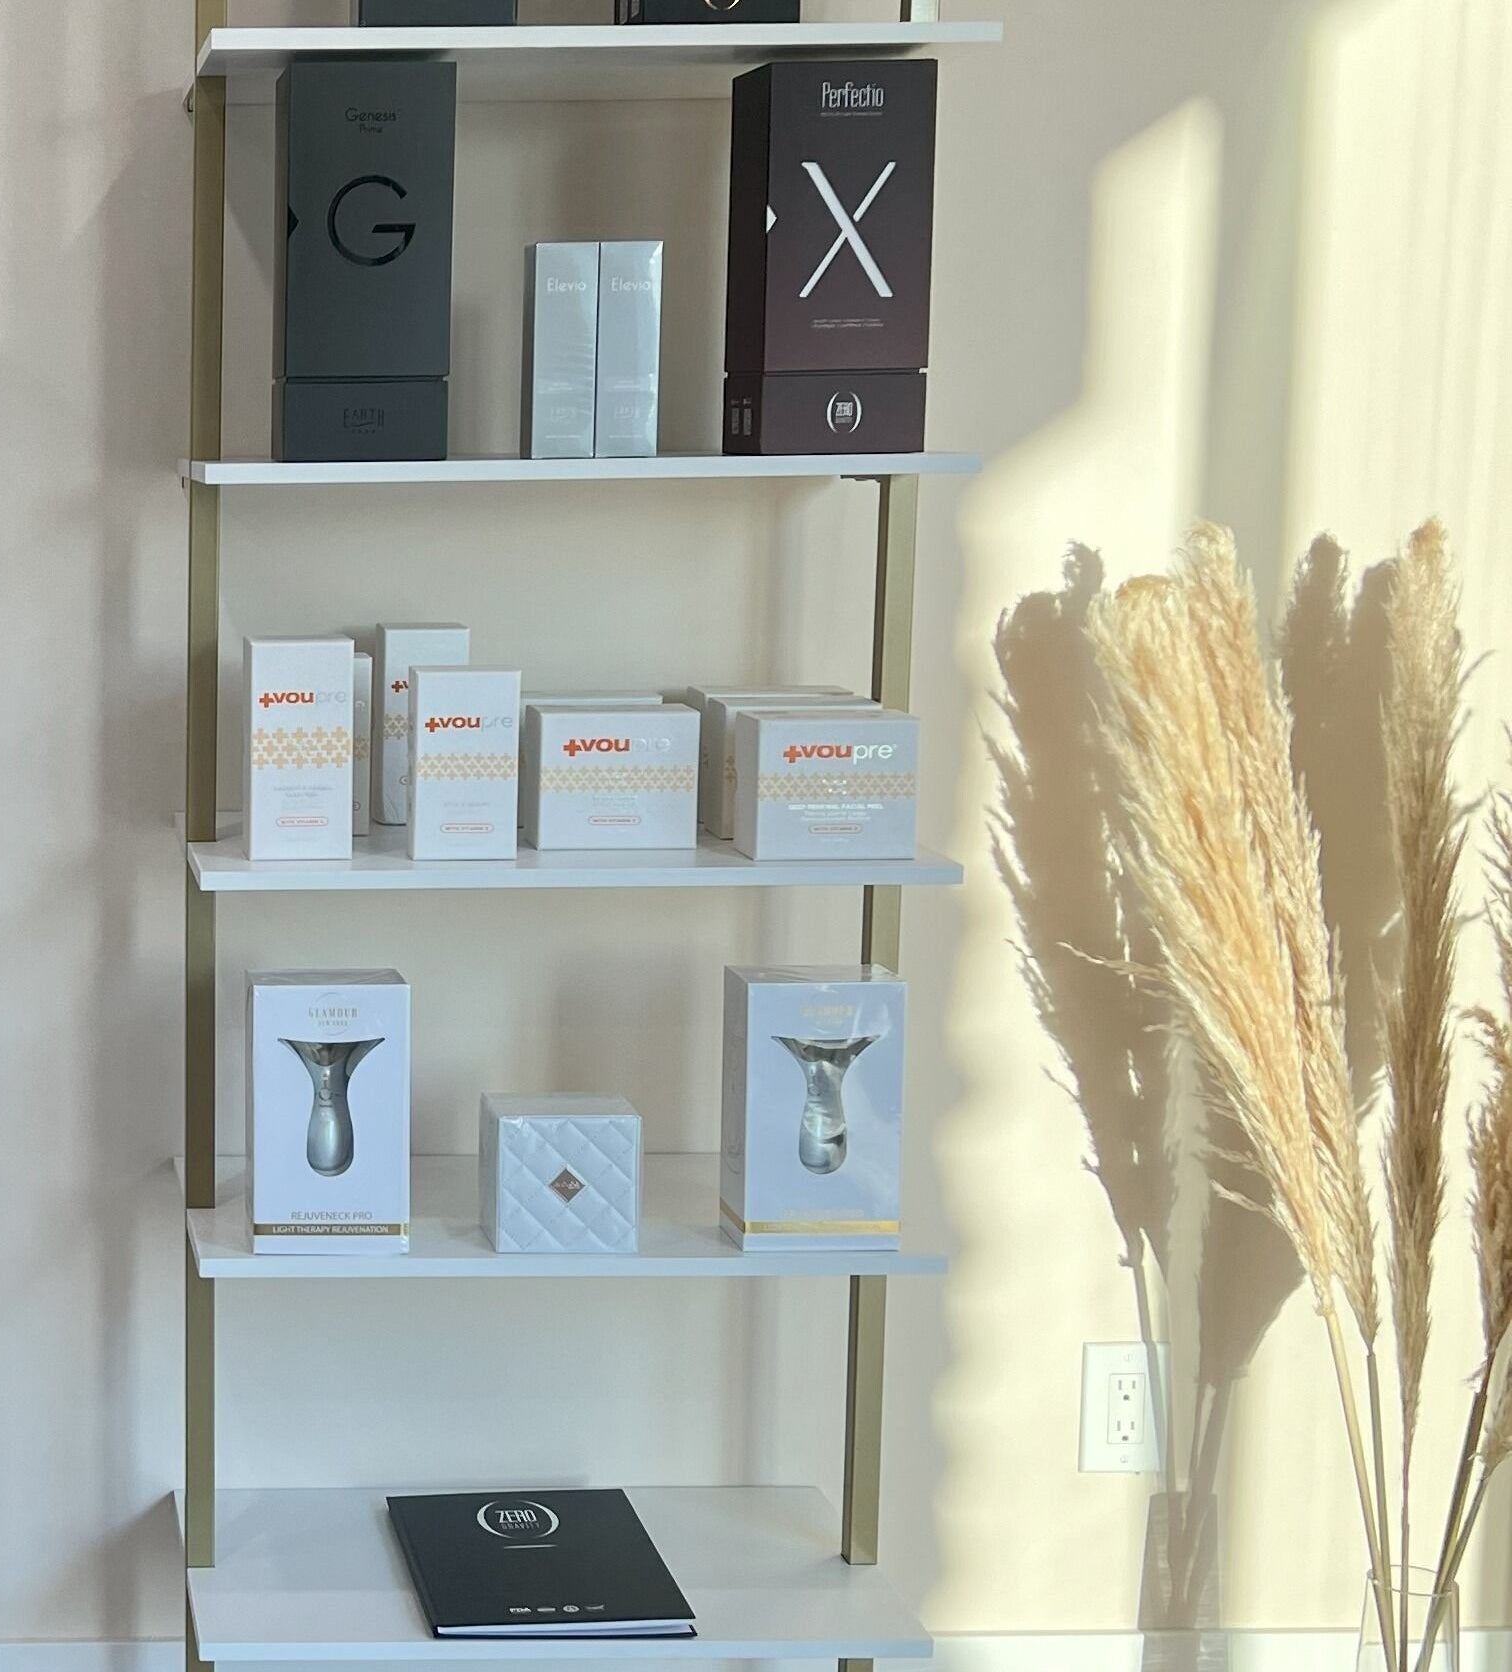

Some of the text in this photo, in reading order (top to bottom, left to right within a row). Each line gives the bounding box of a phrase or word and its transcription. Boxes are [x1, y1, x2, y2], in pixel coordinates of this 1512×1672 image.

[822, 82, 884, 108] Perfectio
[345, 107, 397, 121] Genesis
[327, 175, 416, 267] G
[799, 161, 896, 297] X
[547, 277, 586, 292] Elevio
[291, 1211, 373, 1220] REJUVENECK PRO
[272, 1225, 389, 1233] LIGHT THERAPY REJUVENATION
[494, 1509, 538, 1524] ZERO
